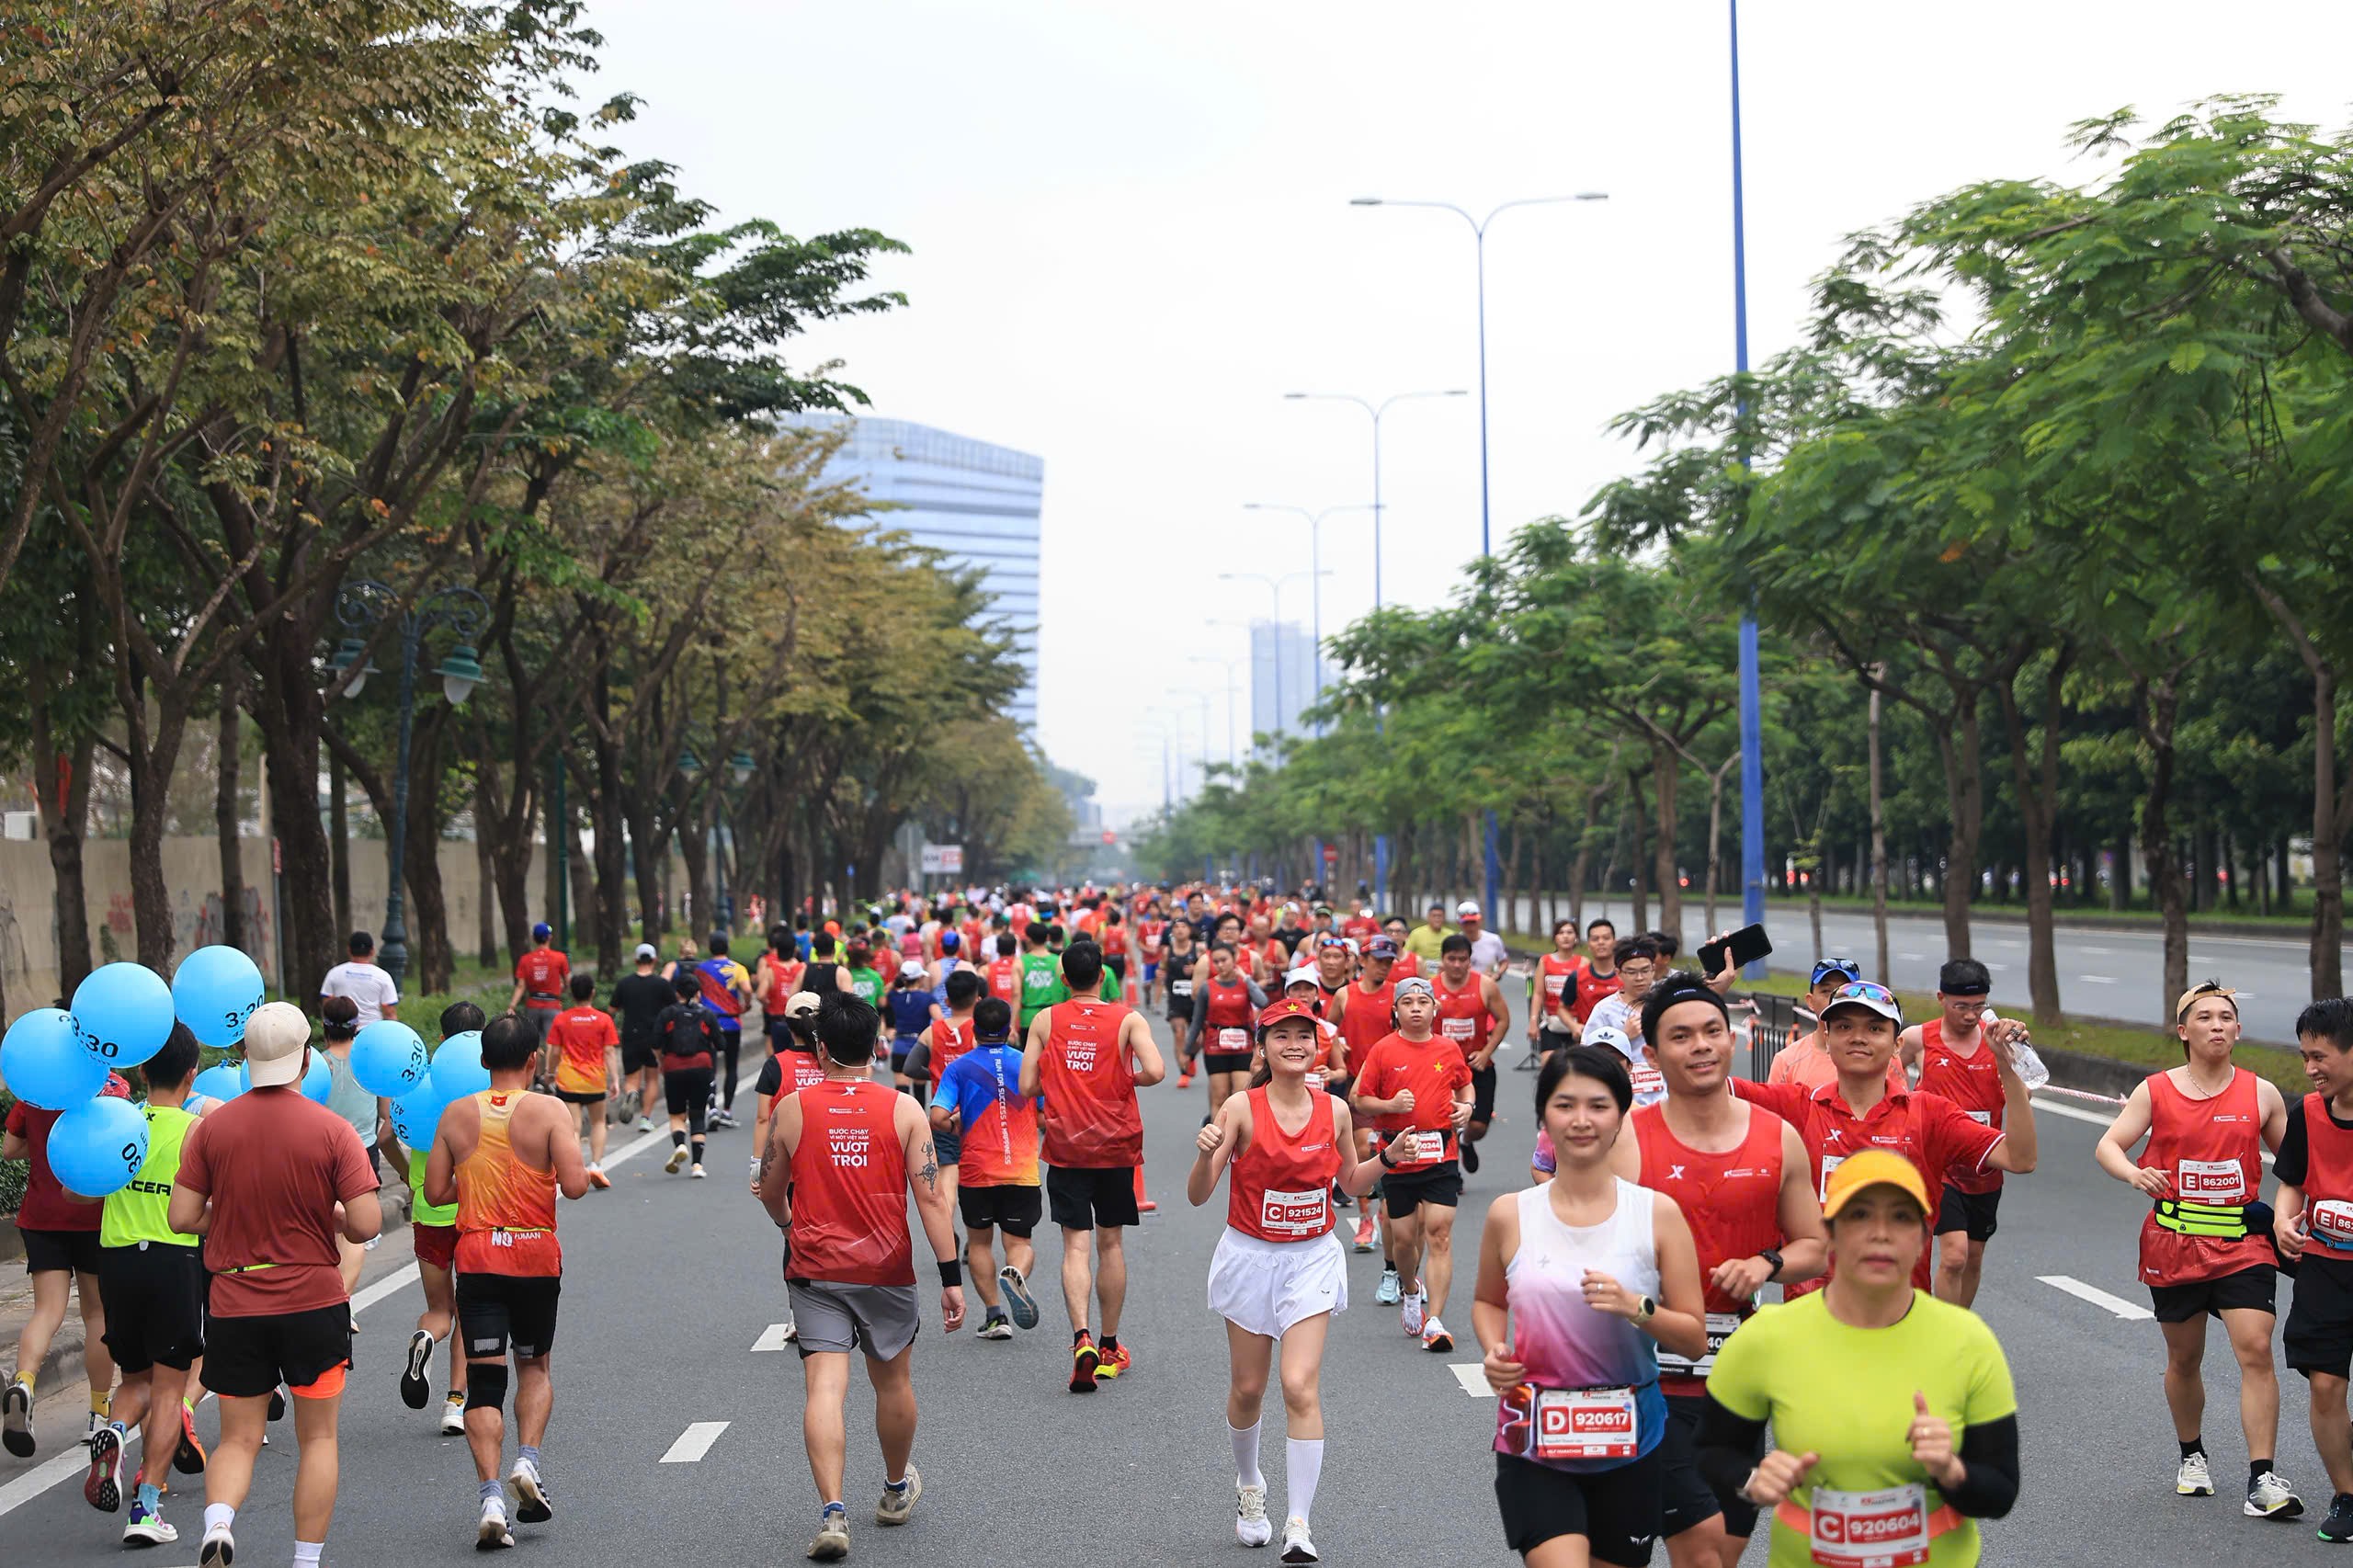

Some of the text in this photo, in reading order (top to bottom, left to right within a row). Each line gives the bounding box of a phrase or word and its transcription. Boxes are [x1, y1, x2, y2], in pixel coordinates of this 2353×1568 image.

[401, 1040, 424, 1082] 3:30
[998, 1087, 1006, 1120] SUCCESS
[2186, 1175, 2239, 1188] E 862001
[1269, 1205, 1322, 1220] C 921524
[2321, 1212, 2331, 1227] E
[491, 1231, 514, 1247] NO
[1546, 1411, 1629, 1431] D 920617
[1818, 1513, 1919, 1539] C 920604
